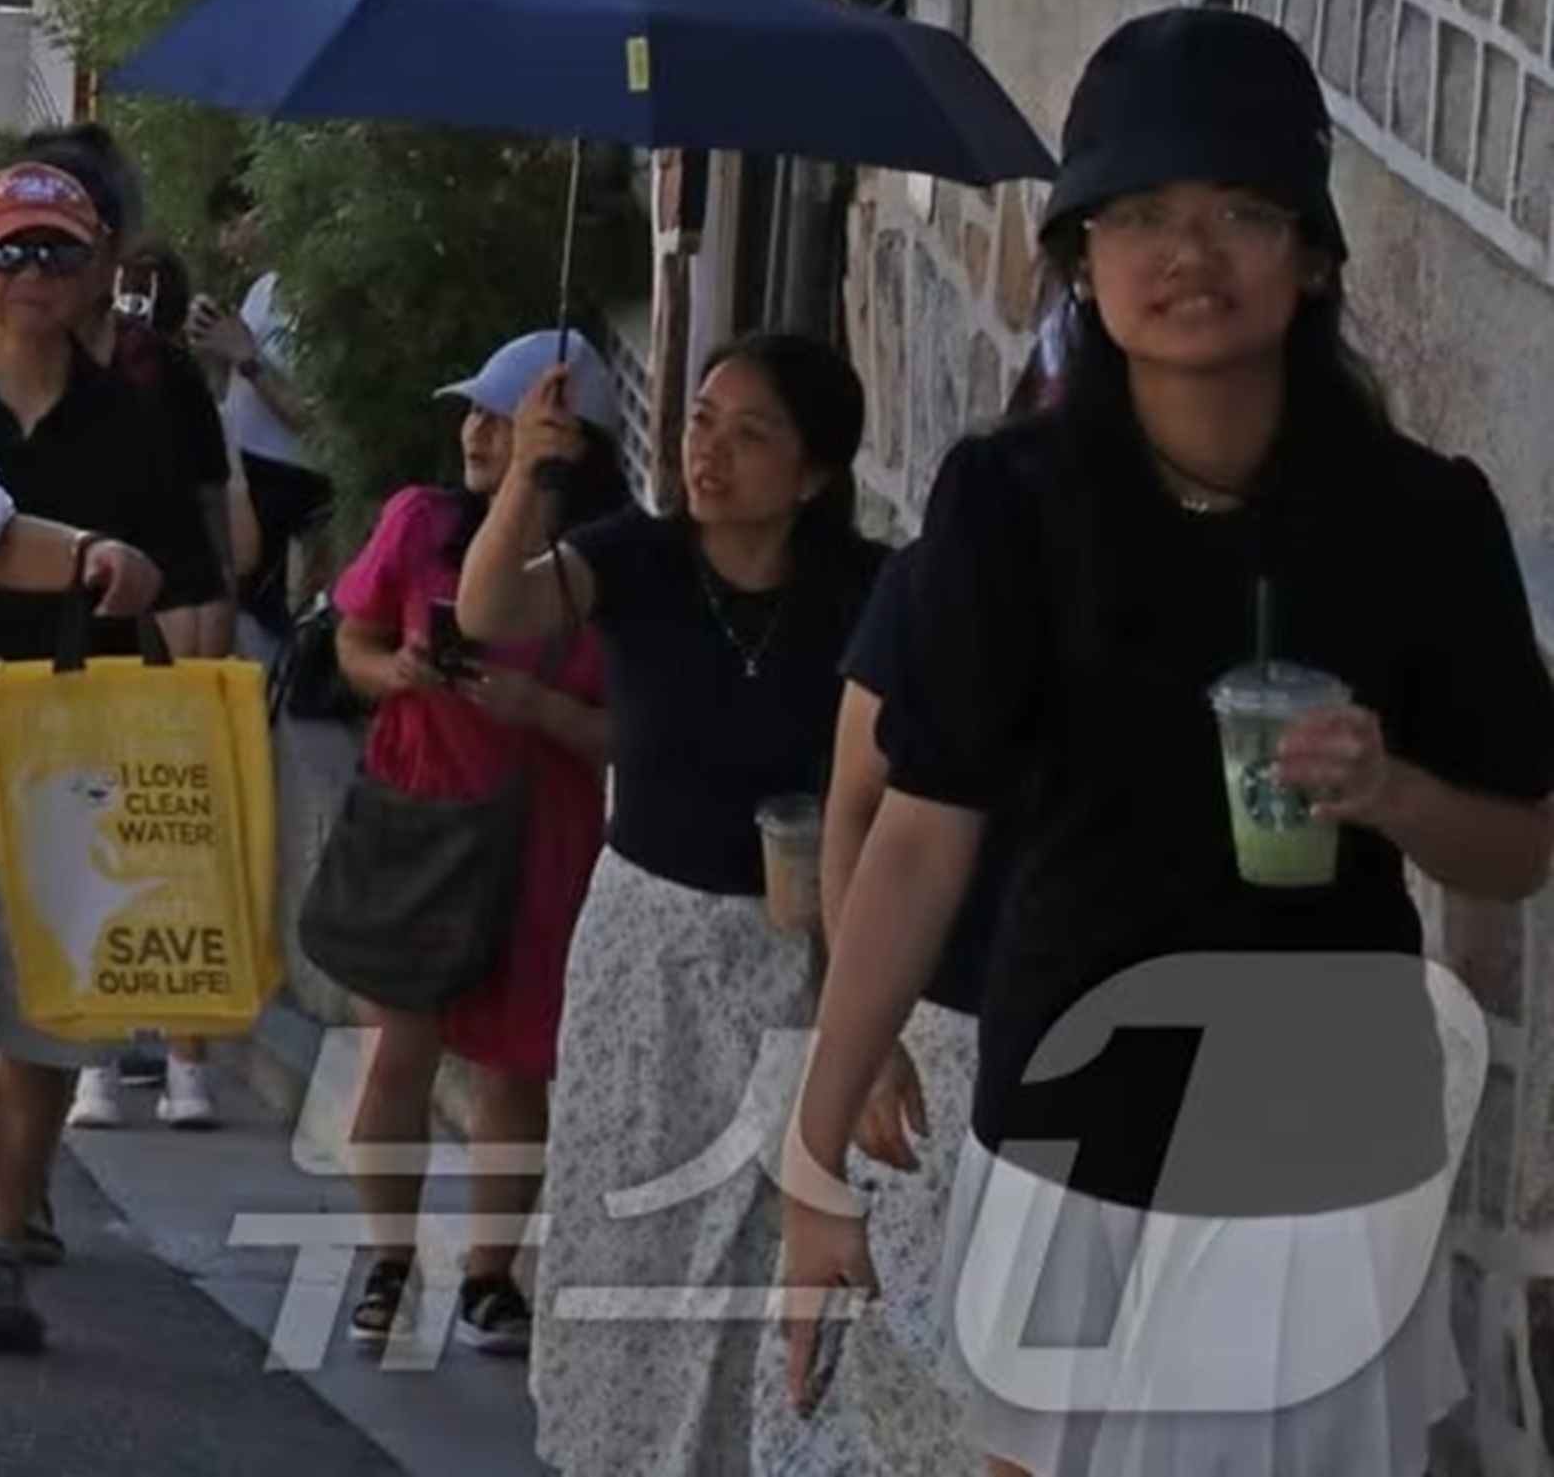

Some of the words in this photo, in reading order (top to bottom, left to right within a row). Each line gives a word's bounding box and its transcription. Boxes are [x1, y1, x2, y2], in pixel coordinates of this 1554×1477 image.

[120, 763, 129, 788] I
[138, 764, 209, 789] LOVE
[124, 792, 212, 817] CLEAN
[117, 821, 215, 846] WATER
[107, 926, 227, 966] SAVE
[97, 970, 160, 995] OUR
[166, 971, 231, 996] LIFE!
